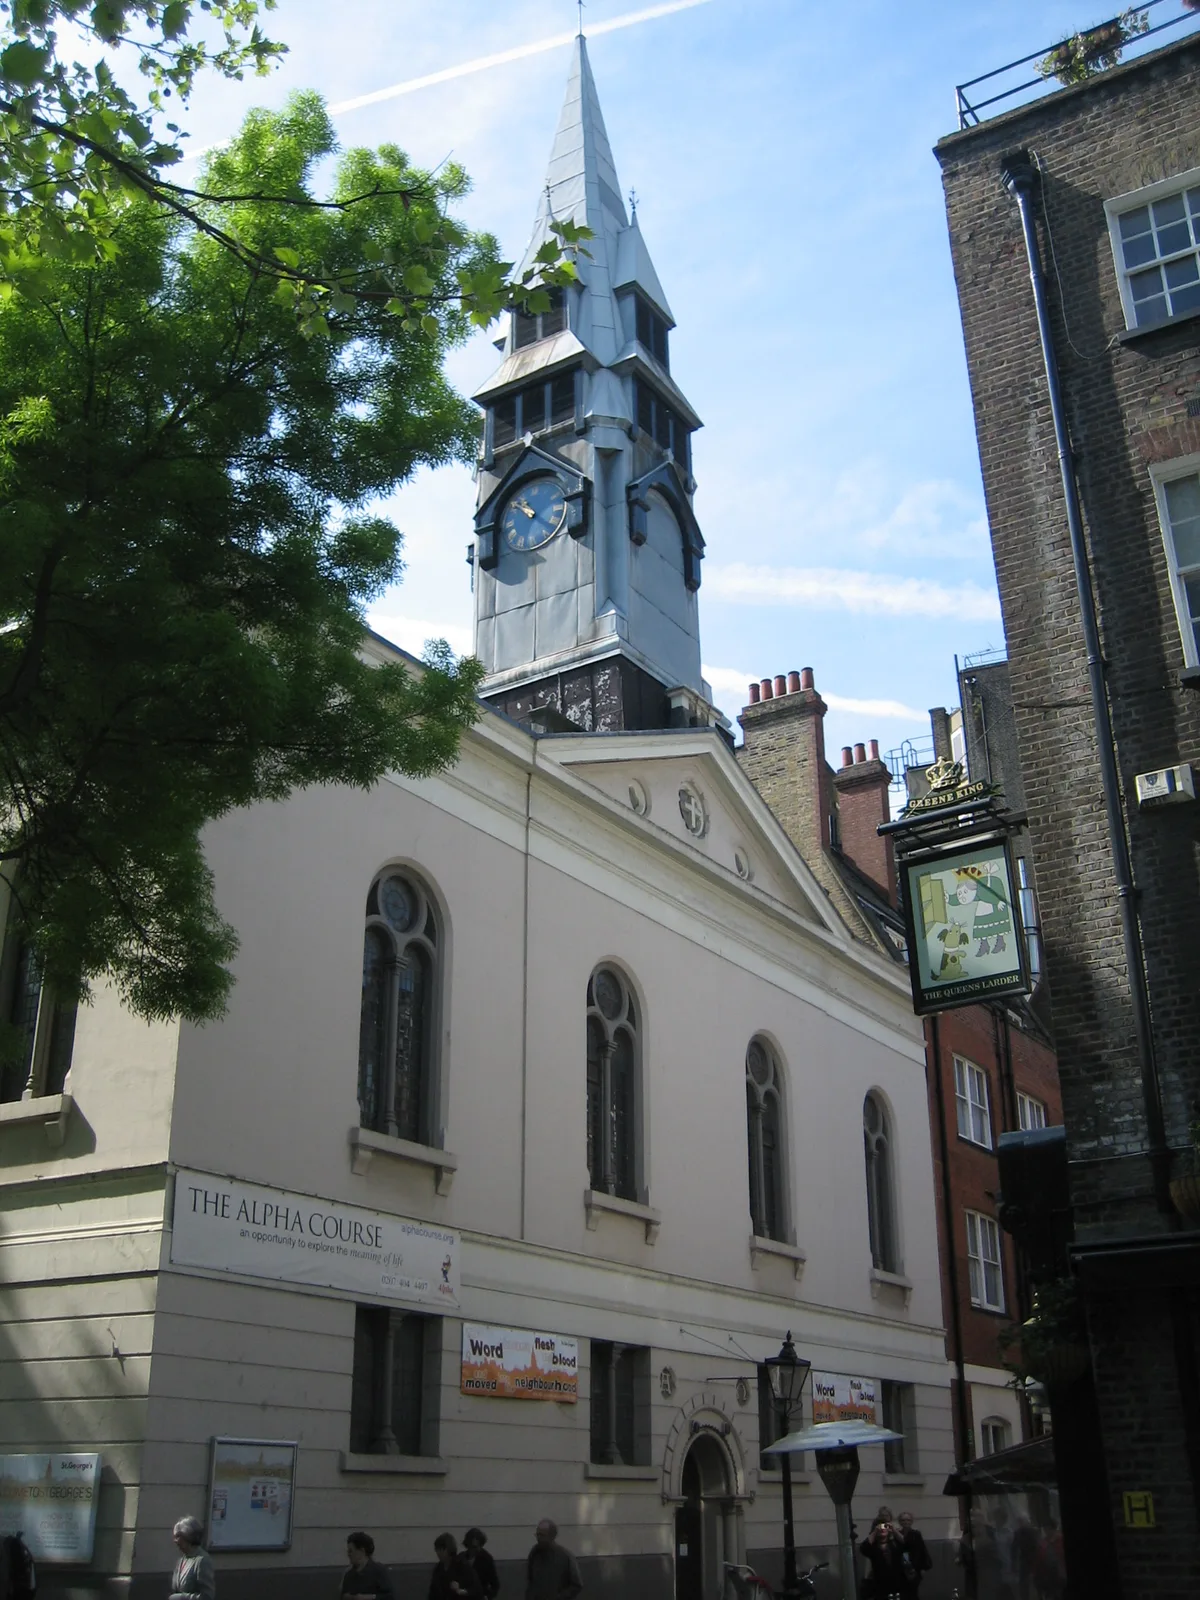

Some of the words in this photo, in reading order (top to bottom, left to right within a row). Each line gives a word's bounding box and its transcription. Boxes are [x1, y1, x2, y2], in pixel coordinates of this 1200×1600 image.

[909, 792, 954, 808] GREENE
[956, 782, 984, 799] KING
[923, 990, 943, 1000] THE
[944, 982, 980, 997] QUEENS
[982, 975, 1019, 989] LARDER
[188, 1187, 231, 1219] THE
[236, 1199, 304, 1233] ALPHA
[308, 1213, 383, 1248] COURSE
[401, 1223, 454, 1245] alphacourse.org
[240, 1229, 250, 1237] an
[251, 1231, 296, 1249] opportunity
[298, 1239, 306, 1248] to
[307, 1241, 335, 1253] explore
[336, 1244, 348, 1256] the
[350, 1248, 381, 1264] meaning
[470, 1339, 503, 1358] Word
[534, 1336, 555, 1351] flesh
[552, 1352, 577, 1368] blood
[465, 1379, 497, 1390] moved
[515, 1377, 577, 1392] neighbourhood
[815, 1383, 835, 1397] Word
[1127, 1495, 1151, 1524] H
